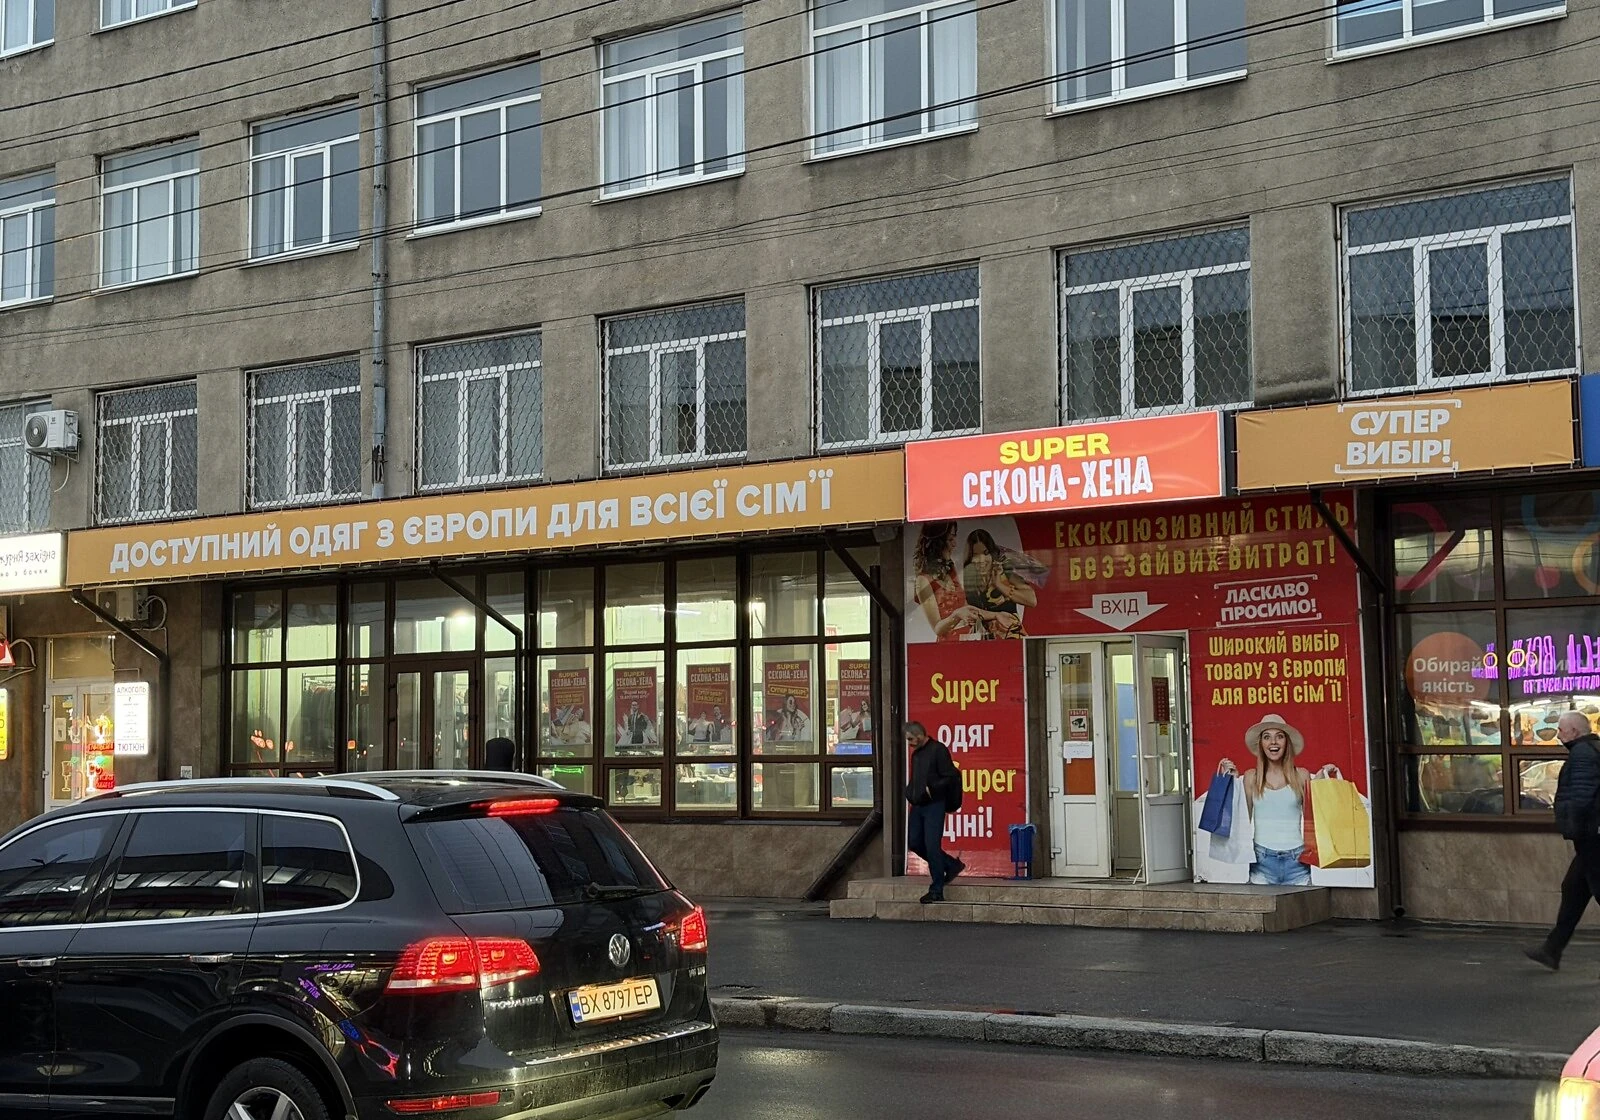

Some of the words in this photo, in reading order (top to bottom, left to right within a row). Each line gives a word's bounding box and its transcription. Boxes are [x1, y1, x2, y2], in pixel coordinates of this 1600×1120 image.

[1350, 409, 1449, 435] СУПЕР
[1000, 433, 1110, 464] SUPER
[1346, 439, 1451, 465] ВИБІР!
[963, 456, 1153, 508] СЕКОНД-ХЕНД
[109, 522, 281, 574] ДОСТУПНИЙ
[289, 521, 368, 557] ОДЯГ
[376, 519, 395, 548] З
[403, 506, 537, 545] ЄВРОПИ
[547, 498, 619, 539] ДЛЯ
[630, 478, 728, 527] ВСІЄЇ
[1123, 544, 1220, 577] зайвих
[1228, 535, 1336, 571] витрат!
[1225, 582, 1309, 604] ЛАСКАВО
[1101, 598, 1139, 616] ВХІД
[1220, 598, 1317, 622] ПРОСИМО!
[1208, 630, 1287, 656] Широкий
[1292, 629, 1340, 653] вибір
[1204, 661, 1263, 681] товару
[1282, 658, 1346, 678] Європи
[116, 686, 147, 694] АЛКОГОЛЬ
[930, 672, 999, 711] Super
[1211, 687, 1243, 706] для
[1248, 681, 1289, 705] всієї
[1422, 678, 1475, 693] якість
[118, 743, 145, 752] ТЮТЮН
[937, 724, 994, 752] одяг
[952, 761, 1016, 800] uper
[581, 991, 602, 1015] BX
[603, 988, 632, 1010] 8797
[633, 985, 653, 1006] EP
